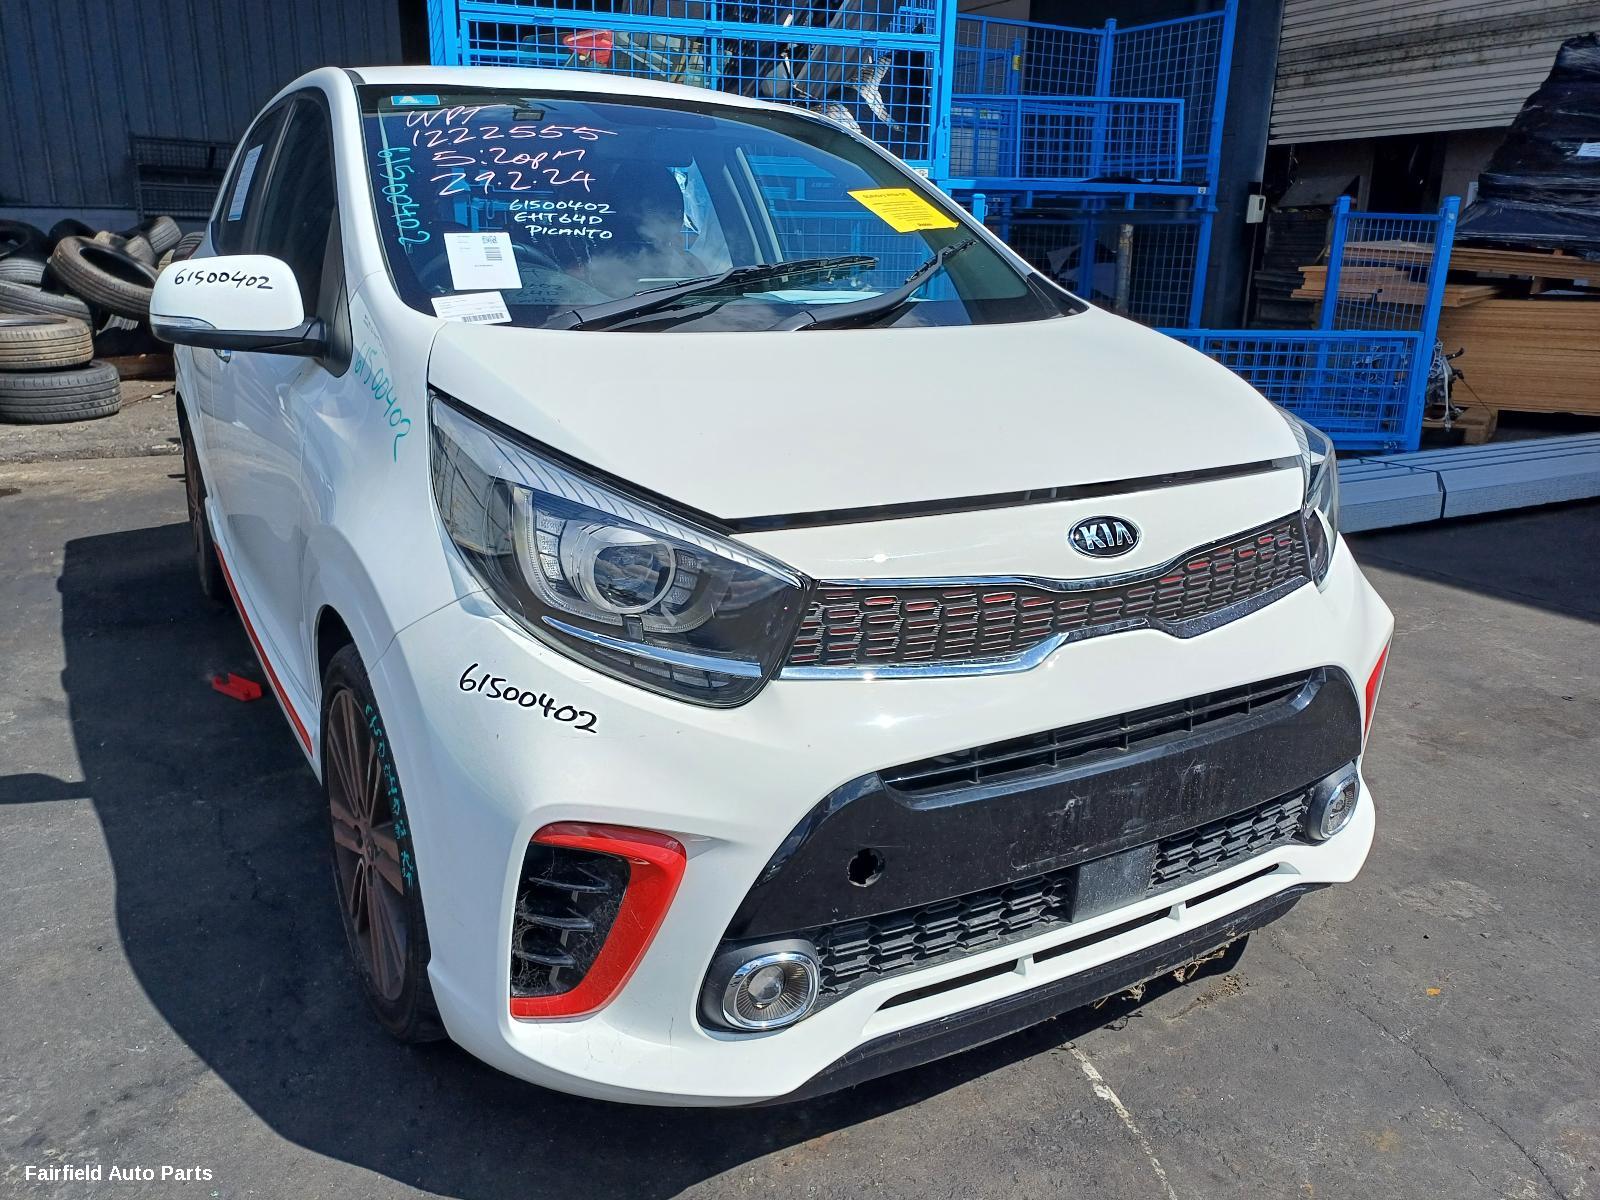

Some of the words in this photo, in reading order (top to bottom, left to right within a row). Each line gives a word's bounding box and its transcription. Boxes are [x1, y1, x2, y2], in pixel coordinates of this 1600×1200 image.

[413, 125, 618, 148] 1222555
[430, 169, 597, 196] 29.2.24
[377, 147, 430, 245] 61500402
[509, 199, 617, 213] 61500402
[525, 225, 613, 239] PICANTO
[174, 268, 273, 290] 61500402
[1078, 521, 1134, 550] KIA
[459, 663, 597, 734] 61500402
